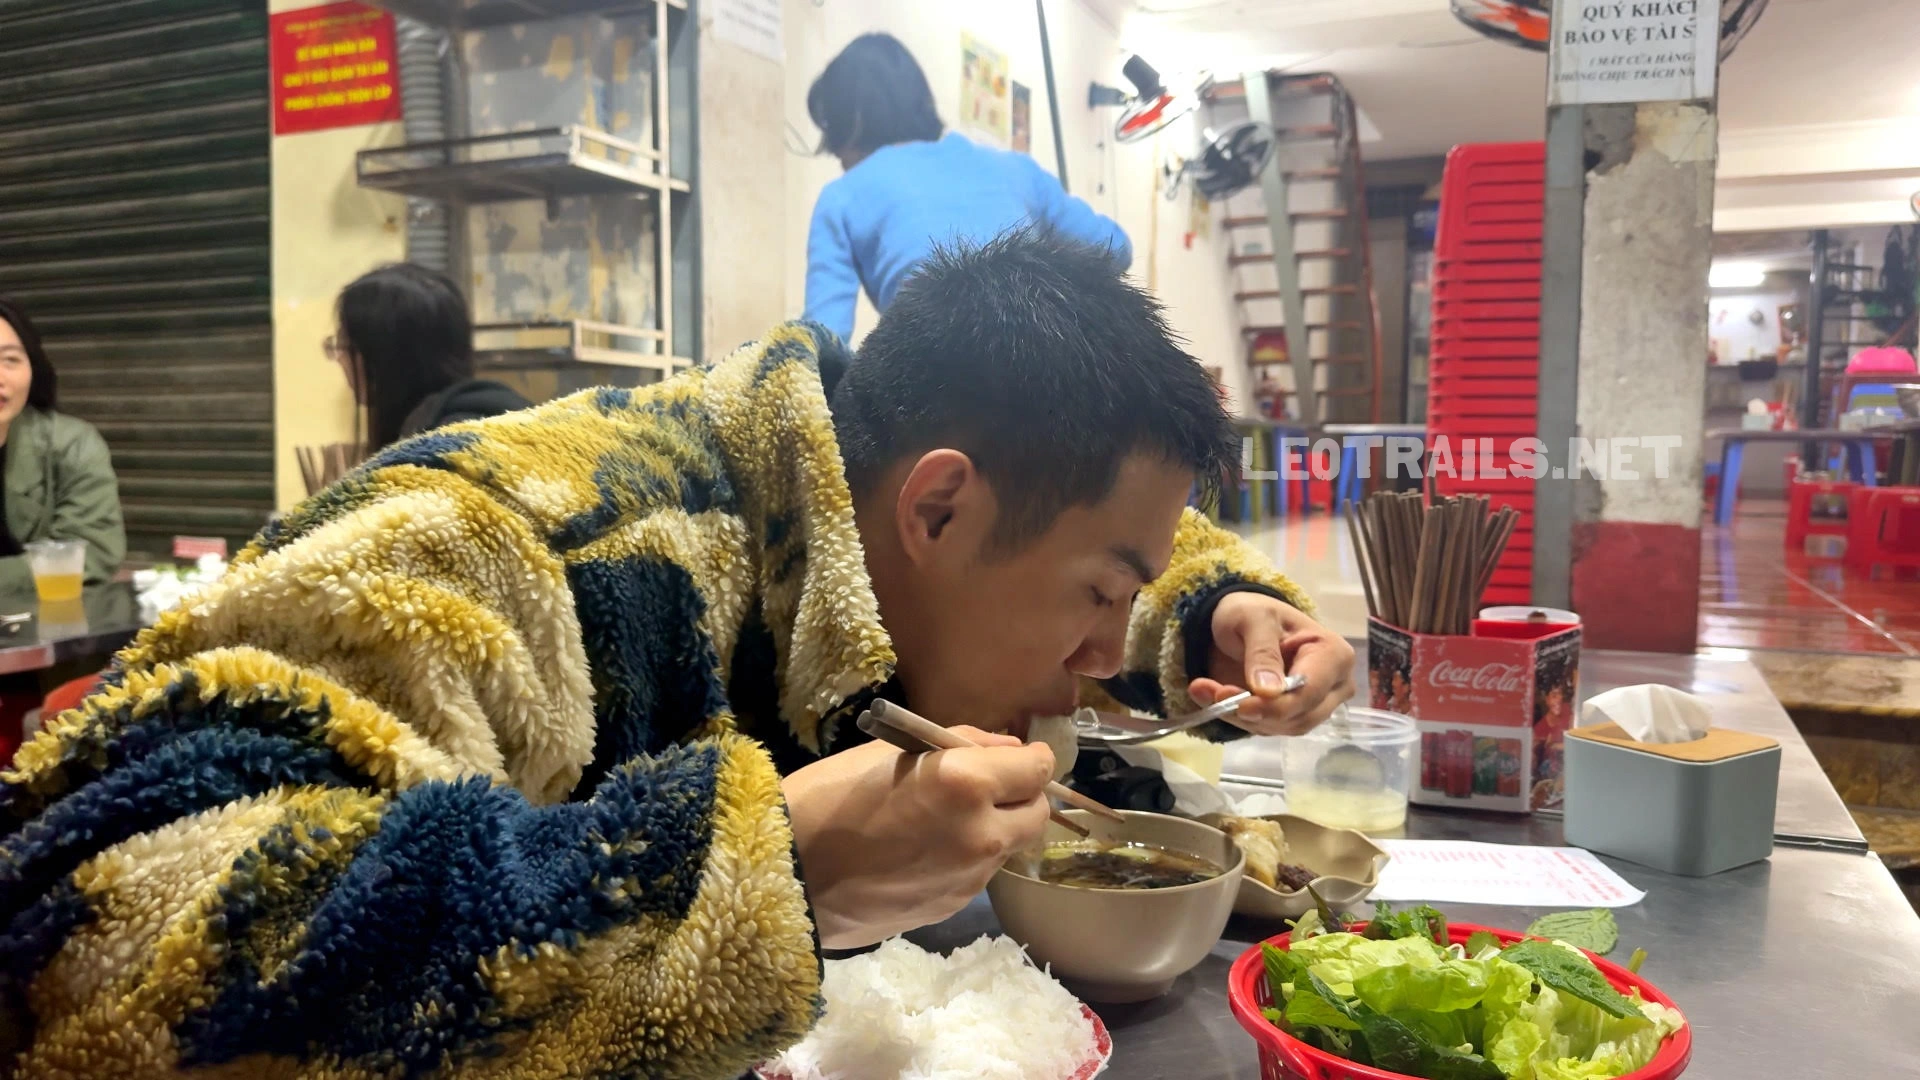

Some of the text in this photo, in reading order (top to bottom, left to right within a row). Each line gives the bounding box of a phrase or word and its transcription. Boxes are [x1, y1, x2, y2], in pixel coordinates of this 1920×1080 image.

[1583, 2, 1626, 22] QUÝ
[1611, 27, 1637, 45] VỆ
[1643, 22, 1676, 40] TÀI
[1429, 660, 1522, 691] Coca-Cola
